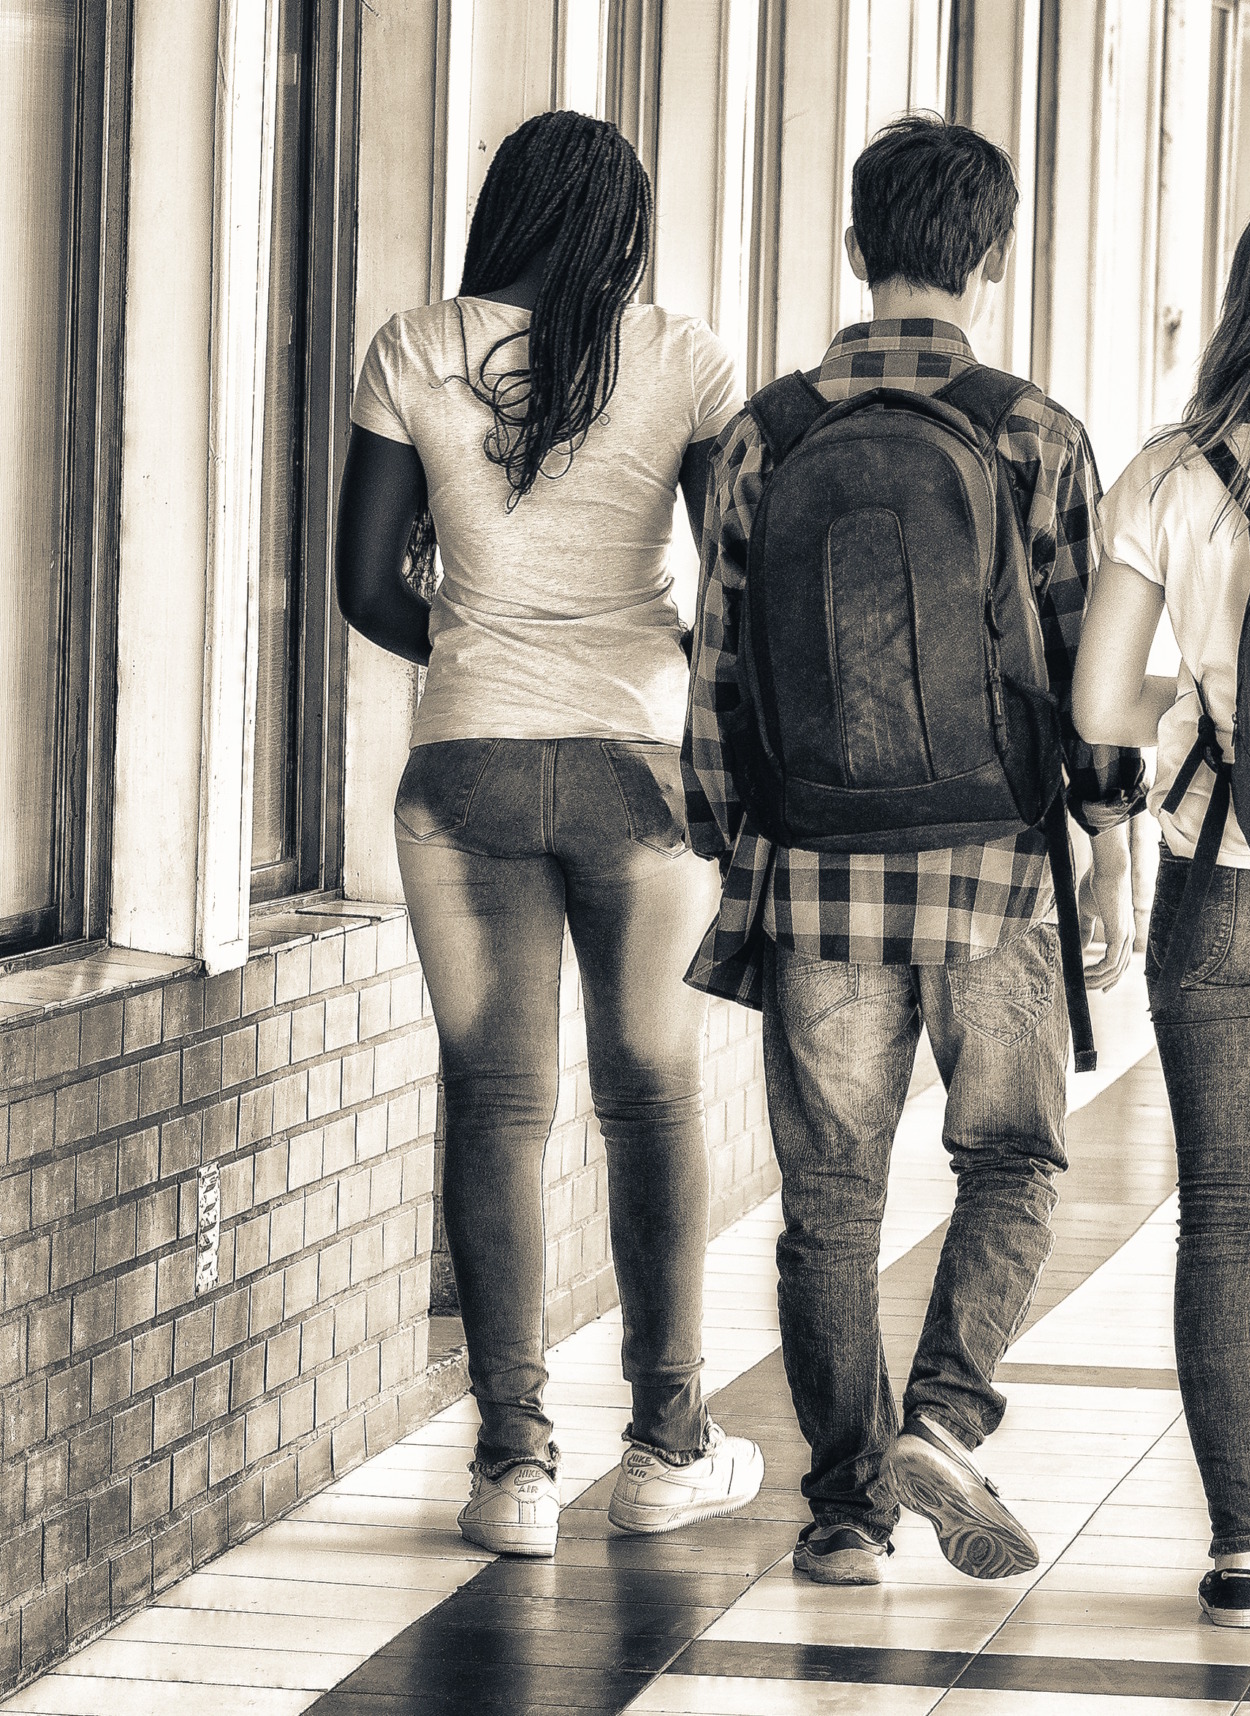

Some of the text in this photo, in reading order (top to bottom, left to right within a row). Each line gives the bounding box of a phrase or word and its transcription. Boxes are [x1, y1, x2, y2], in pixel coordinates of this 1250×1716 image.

[630, 1452, 651, 1464] NIKE
[518, 1469, 541, 1478] NIKE
[627, 1467, 647, 1478] AIR
[517, 1485, 539, 1493] AIR
